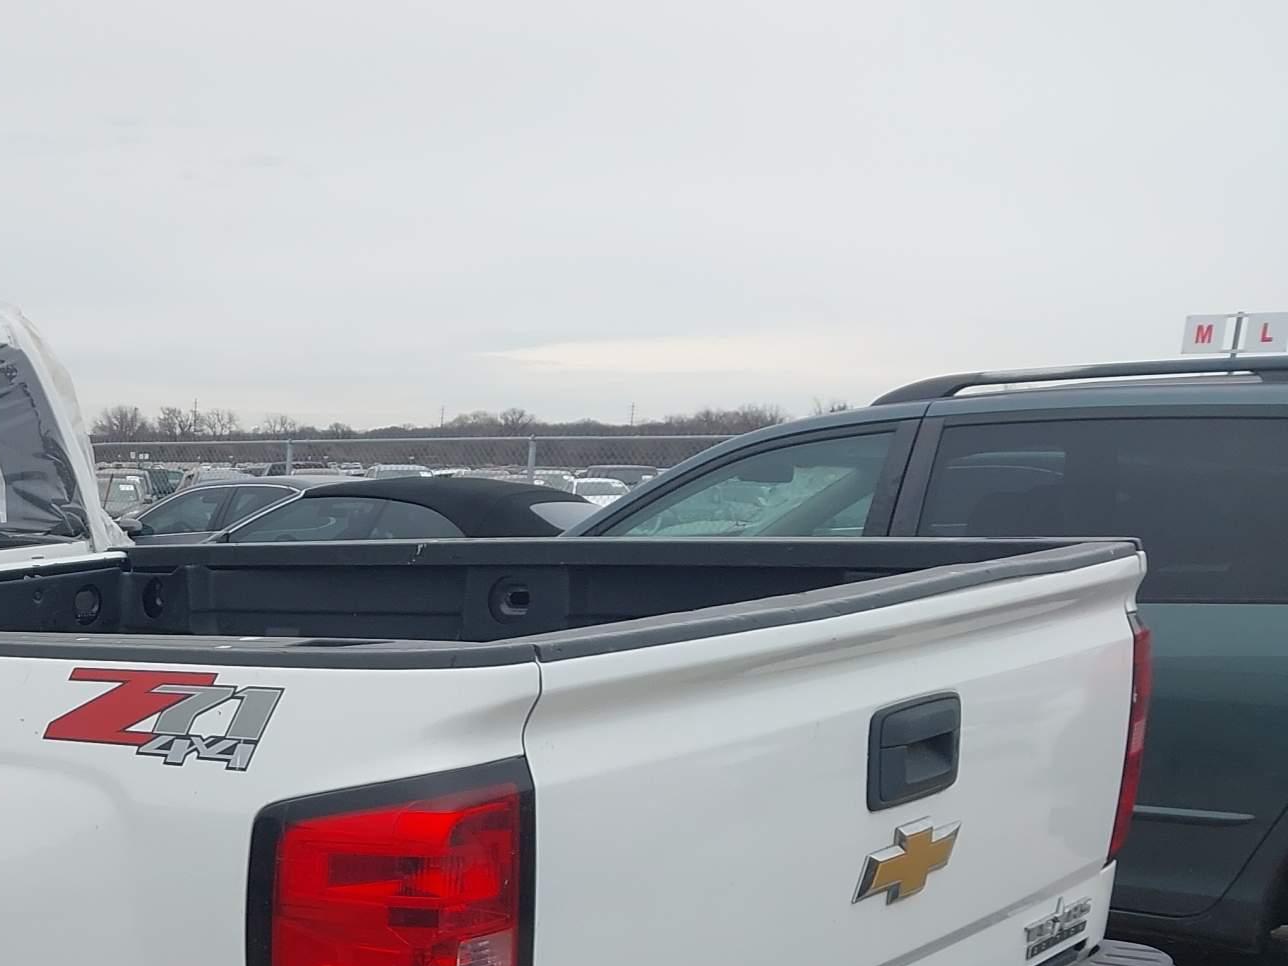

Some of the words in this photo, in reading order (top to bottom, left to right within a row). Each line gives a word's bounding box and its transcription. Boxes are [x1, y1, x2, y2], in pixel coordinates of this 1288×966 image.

[1195, 324, 1214, 344] M
[1260, 322, 1273, 343] L
[43, 667, 285, 746] Z71
